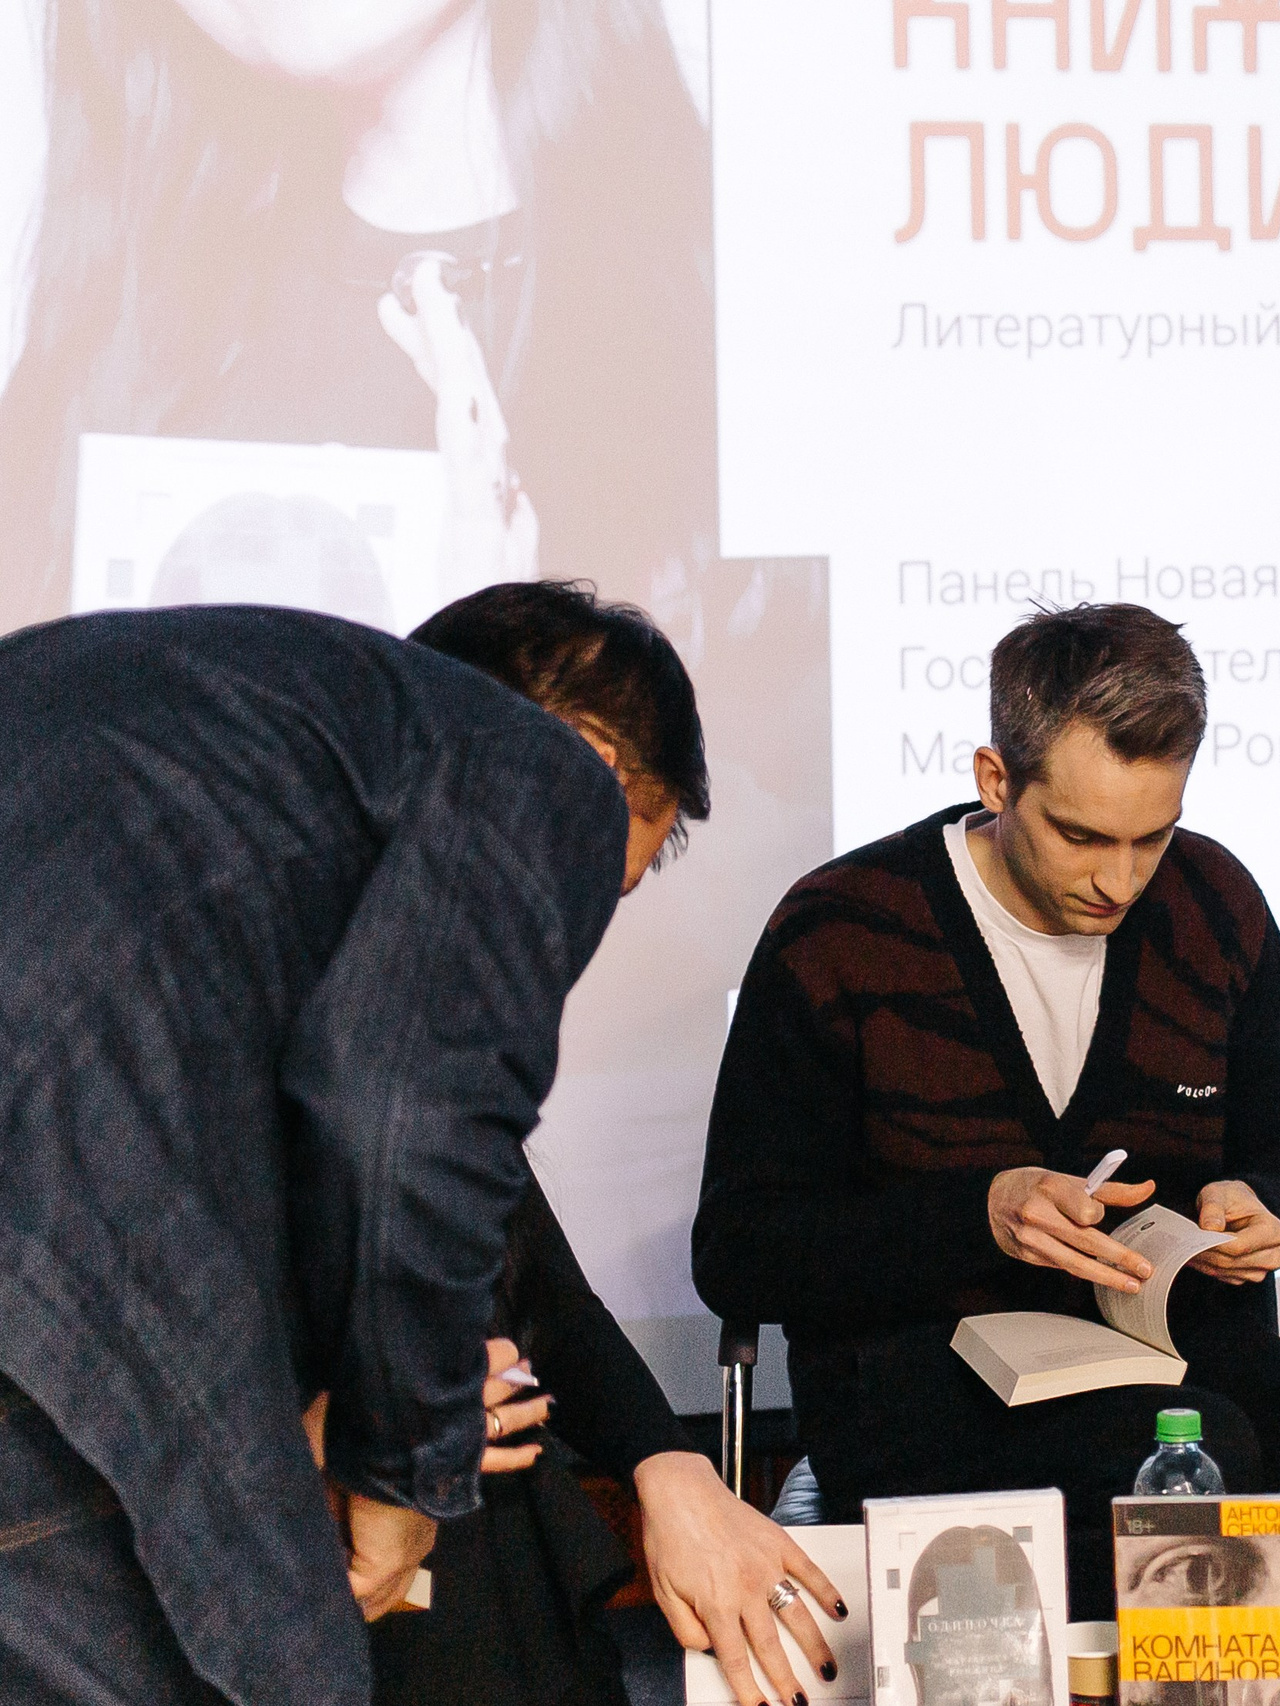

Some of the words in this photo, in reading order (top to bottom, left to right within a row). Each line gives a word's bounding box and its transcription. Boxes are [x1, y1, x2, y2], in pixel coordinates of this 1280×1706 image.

[898, 559, 1097, 606] Панель
[1115, 556, 1279, 600] Новая
[1127, 1519, 1155, 1535] 18+
[1132, 1633, 1280, 1660] КОМНАТА
